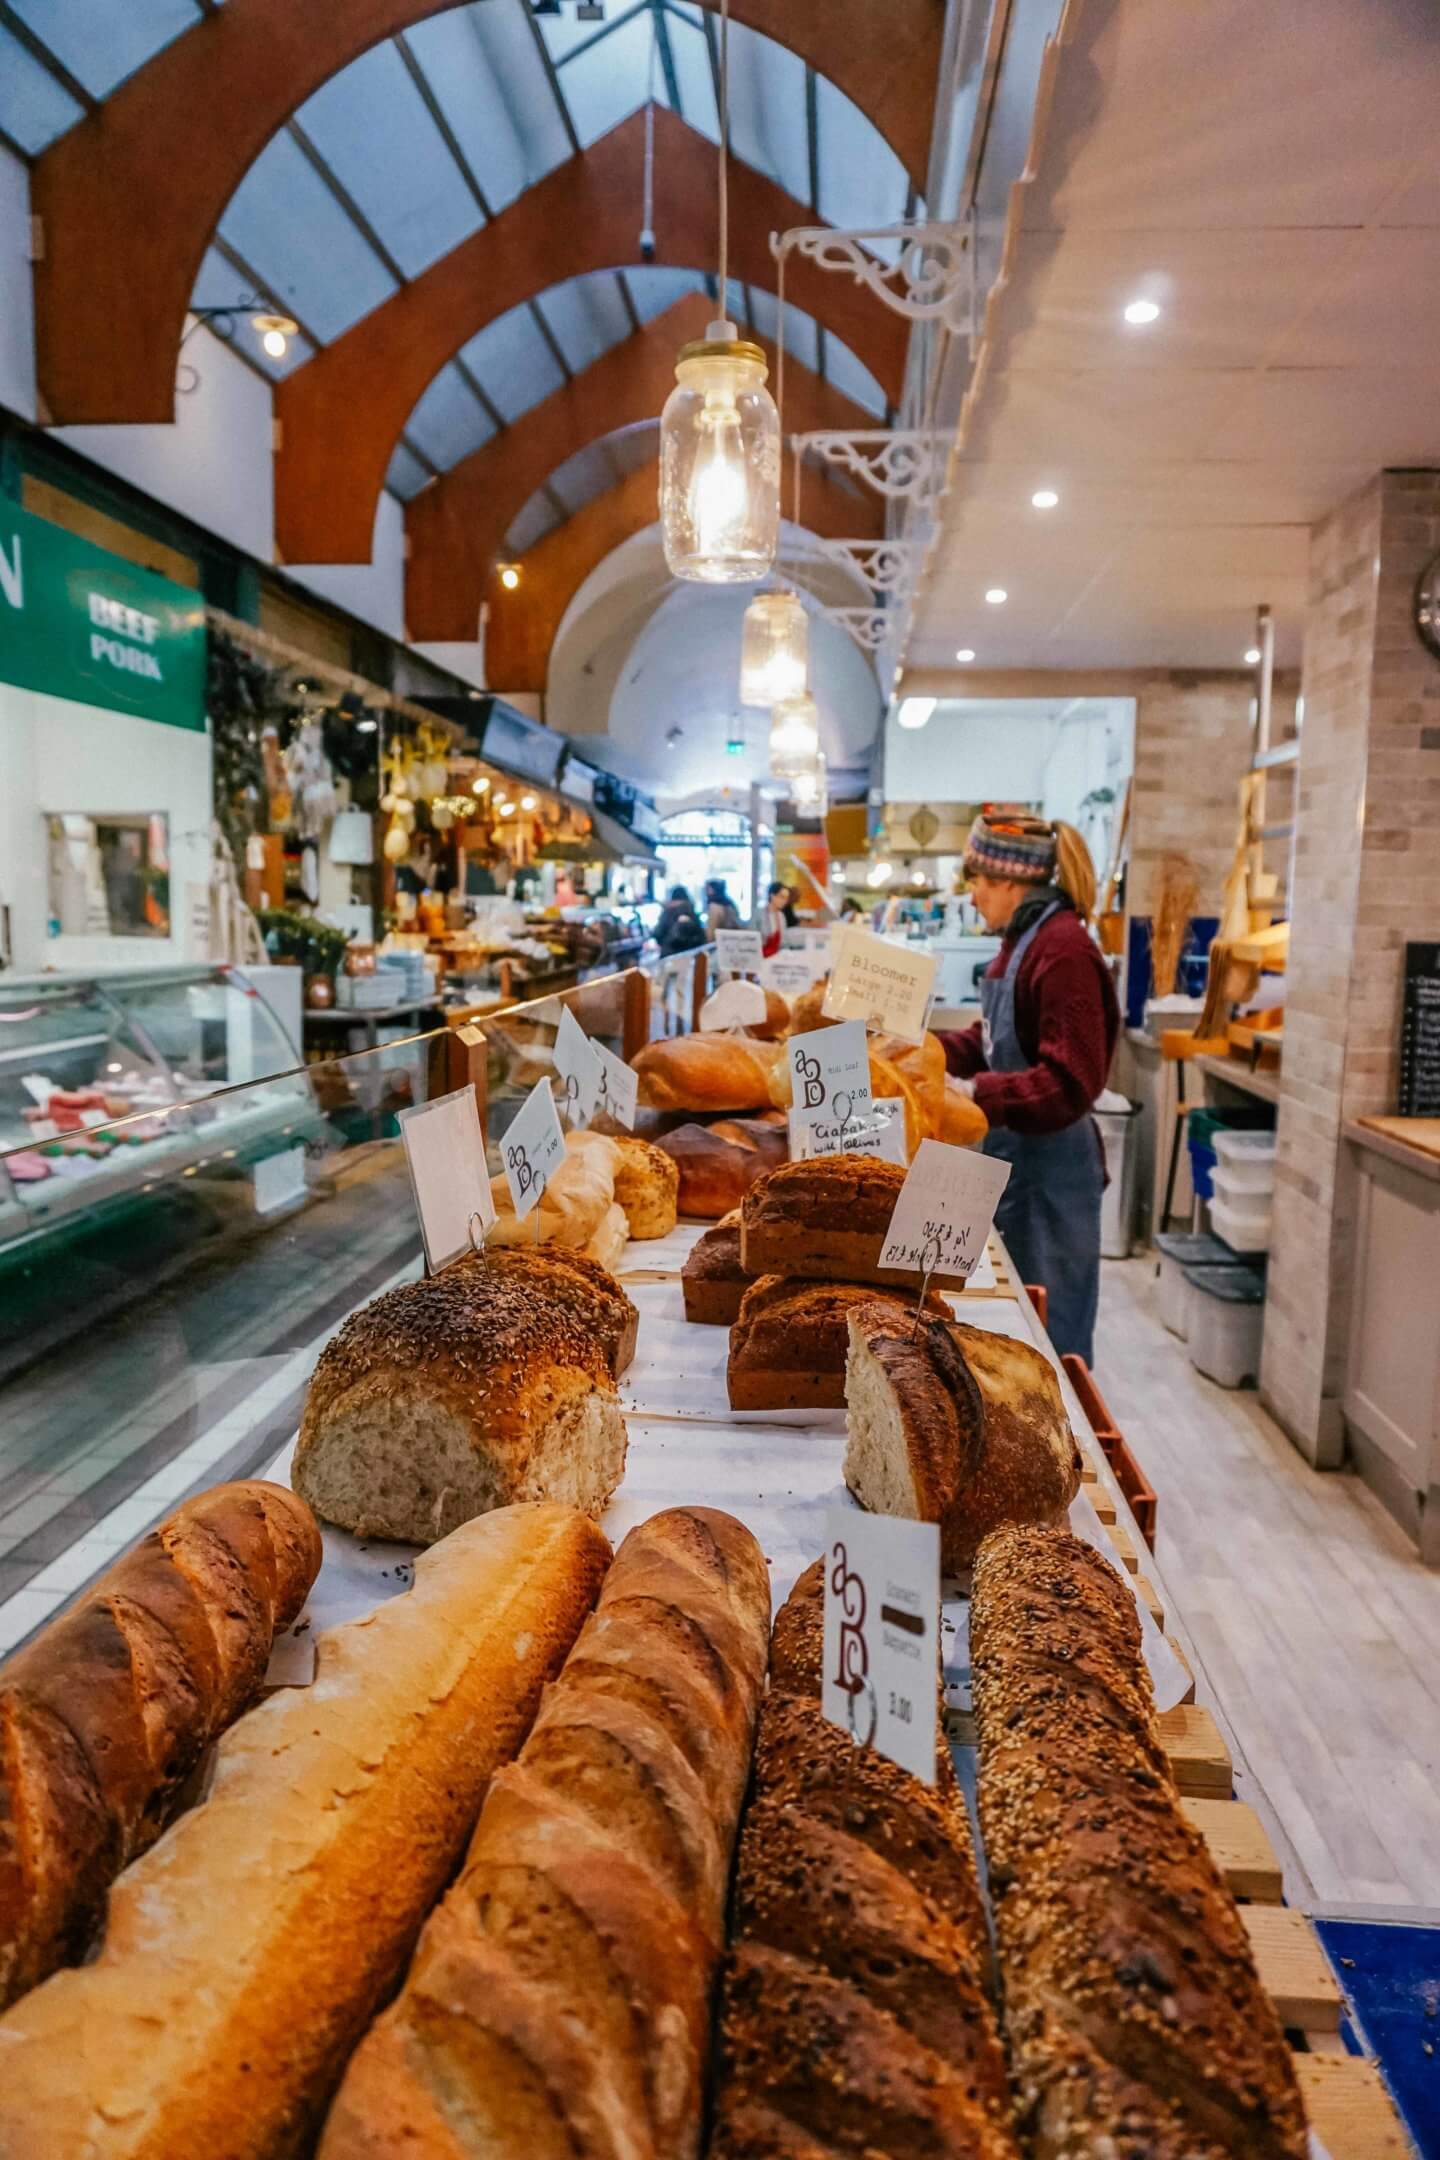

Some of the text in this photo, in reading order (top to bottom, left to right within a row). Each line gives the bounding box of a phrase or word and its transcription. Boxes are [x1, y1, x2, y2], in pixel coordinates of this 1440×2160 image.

[88, 592, 160, 645] BEEF
[90, 633, 162, 681] PORK
[851, 954, 918, 987] Bloomer
[851, 1088, 868, 1100] 2.00
